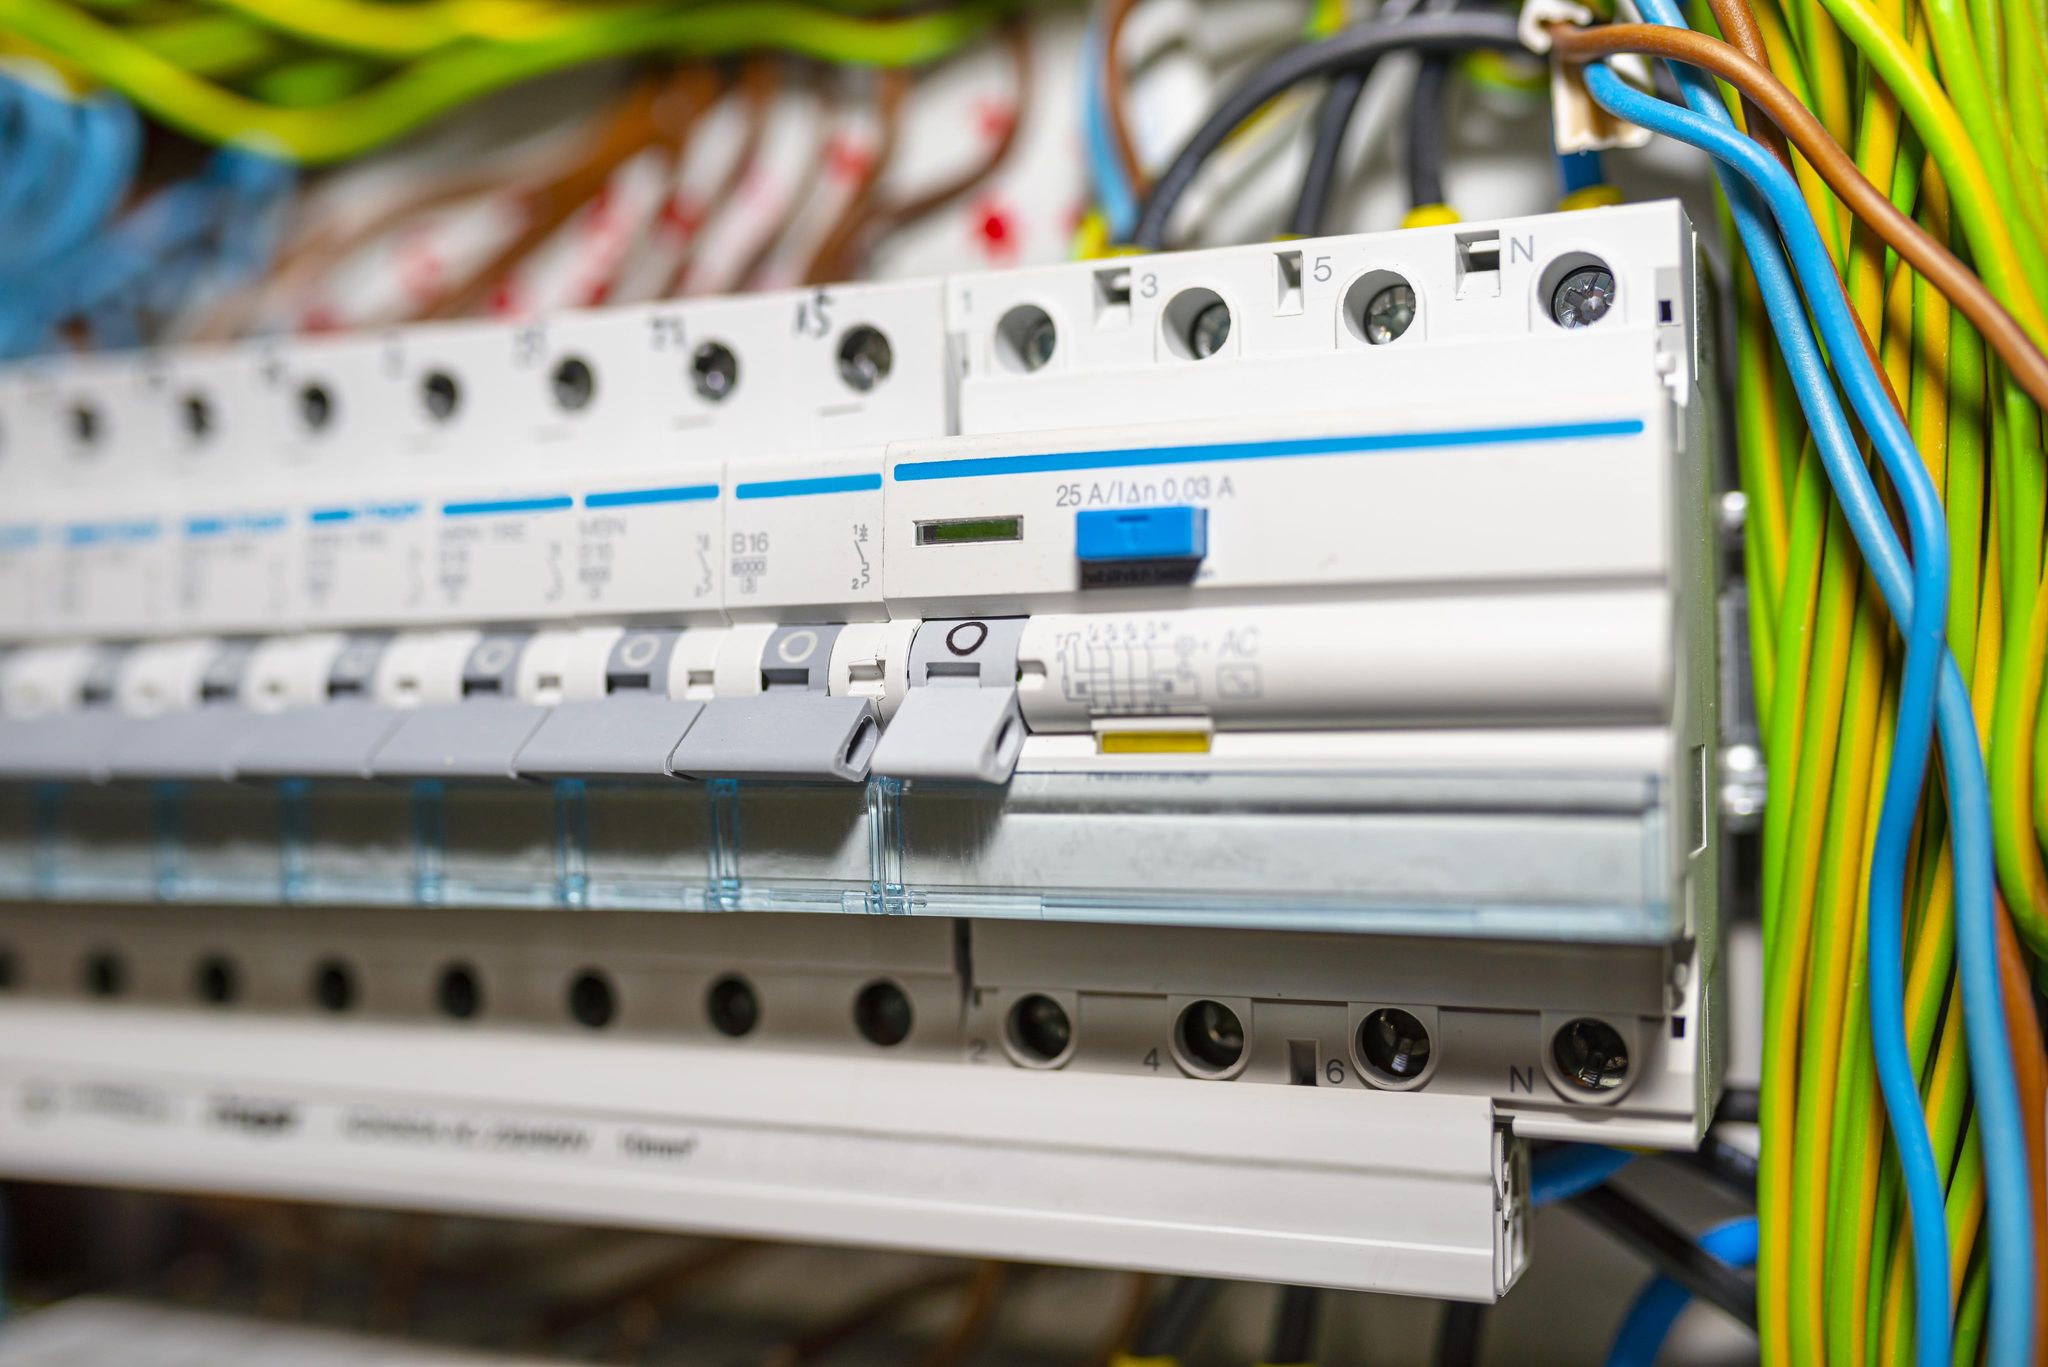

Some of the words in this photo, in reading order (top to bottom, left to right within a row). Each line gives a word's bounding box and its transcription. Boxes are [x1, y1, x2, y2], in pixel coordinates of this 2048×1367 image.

[1511, 235, 1534, 264] N
[1313, 256, 1332, 282] 5
[1140, 273, 1158, 299] 3
[1056, 484, 1082, 507] 25
[1217, 475, 1235, 497] A
[731, 532, 769, 553] B16
[969, 1038, 987, 1063] 2
[1143, 1046, 1160, 1071] 4
[1326, 1059, 1344, 1084] 6
[1510, 1065, 1532, 1093] N
